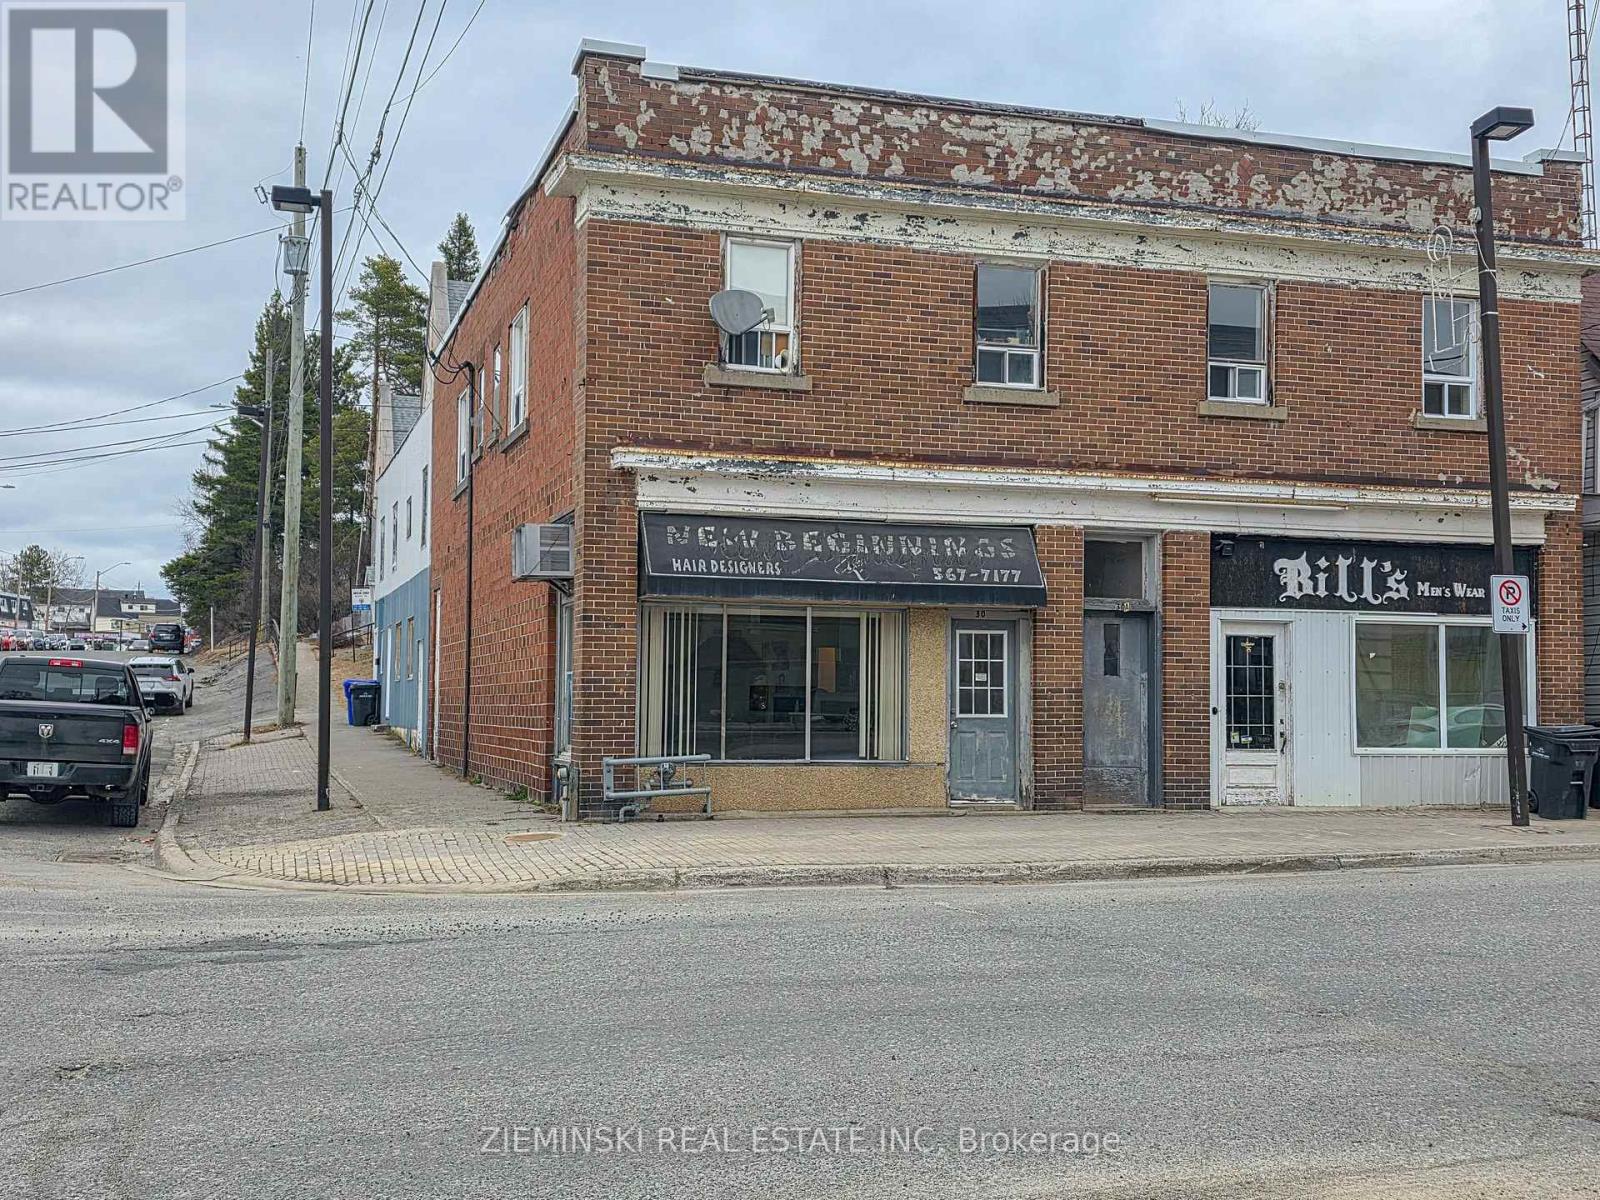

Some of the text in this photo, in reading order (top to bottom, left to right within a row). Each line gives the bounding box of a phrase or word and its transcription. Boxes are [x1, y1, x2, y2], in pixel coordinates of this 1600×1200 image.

[666, 525, 1017, 558] NEW BEGINNINGS
[671, 558, 782, 576] HAIR DESIGNERS
[932, 567, 1021, 583] 567-7177
[1273, 550, 1410, 604] Bill's
[1501, 606, 1521, 615] TAXIS
[1502, 614, 1520, 622] ONLY
